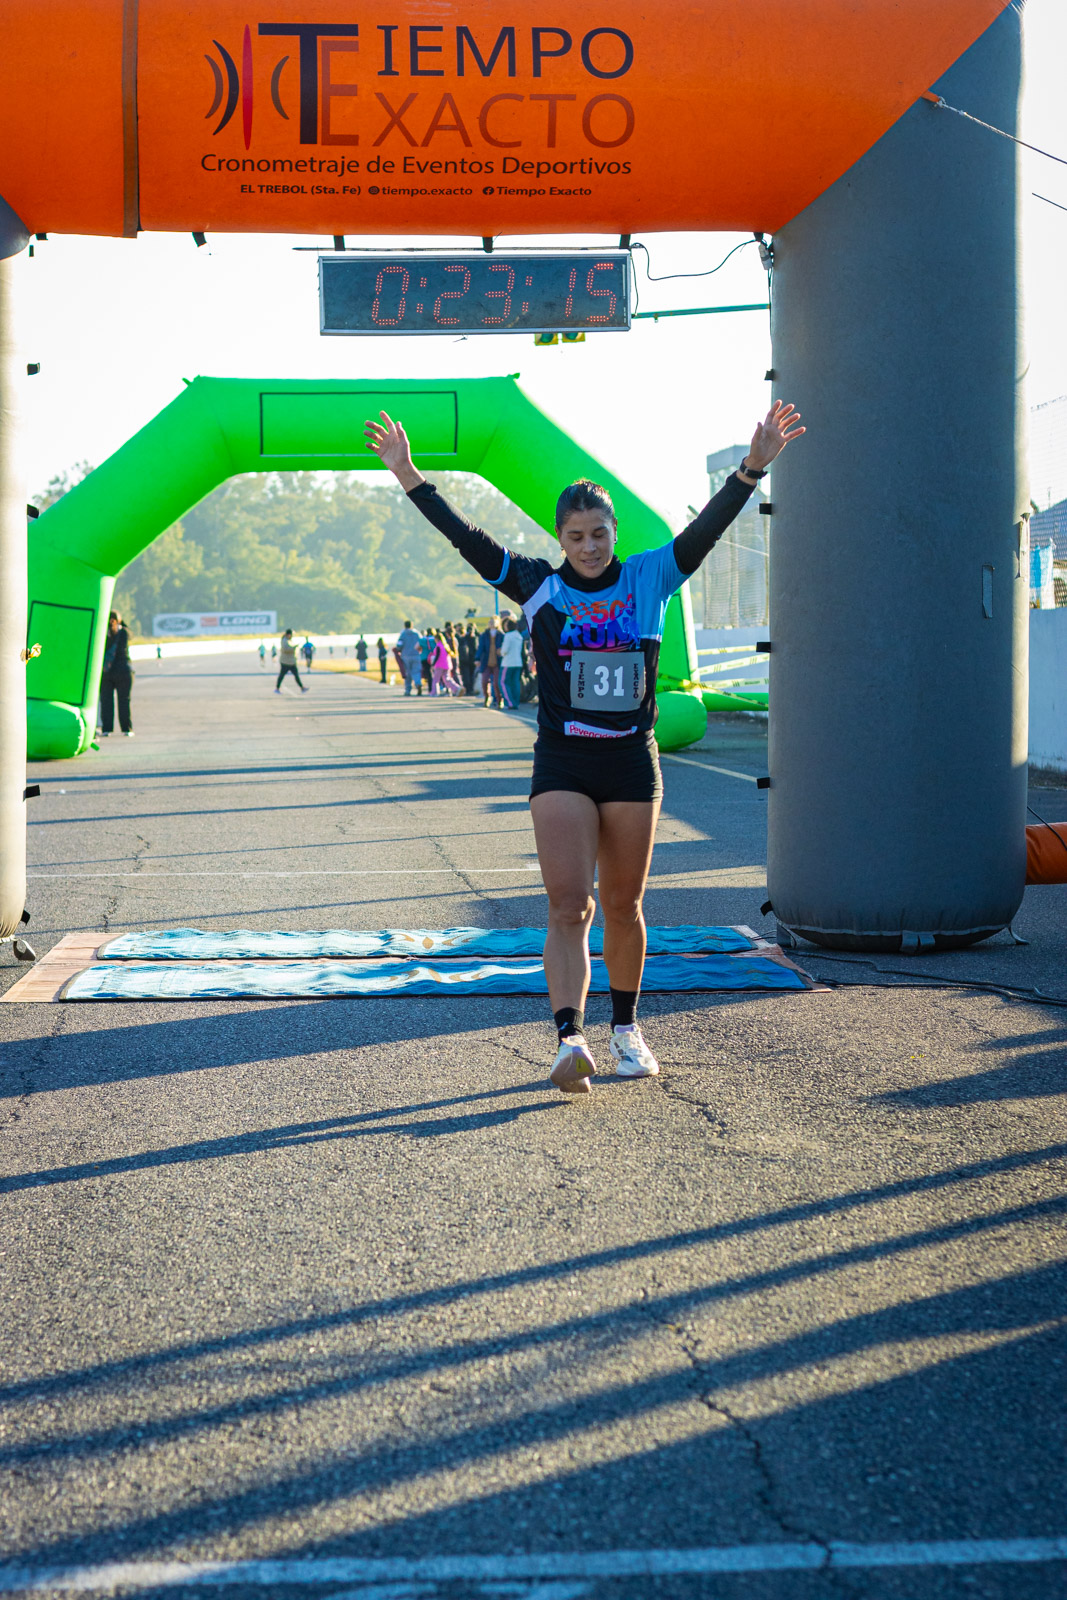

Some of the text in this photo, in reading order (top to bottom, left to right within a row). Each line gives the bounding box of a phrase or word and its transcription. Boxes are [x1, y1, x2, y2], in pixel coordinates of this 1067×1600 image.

[201, 154, 632, 178] Cronometraje de Eventos Deportivos
[240, 184, 361, 195] EL TREBOL (Sta. Fe)
[496, 186, 592, 197] Tiempo Exacto
[577, 662, 585, 699] TIEMPO
[593, 665, 625, 697] 31
